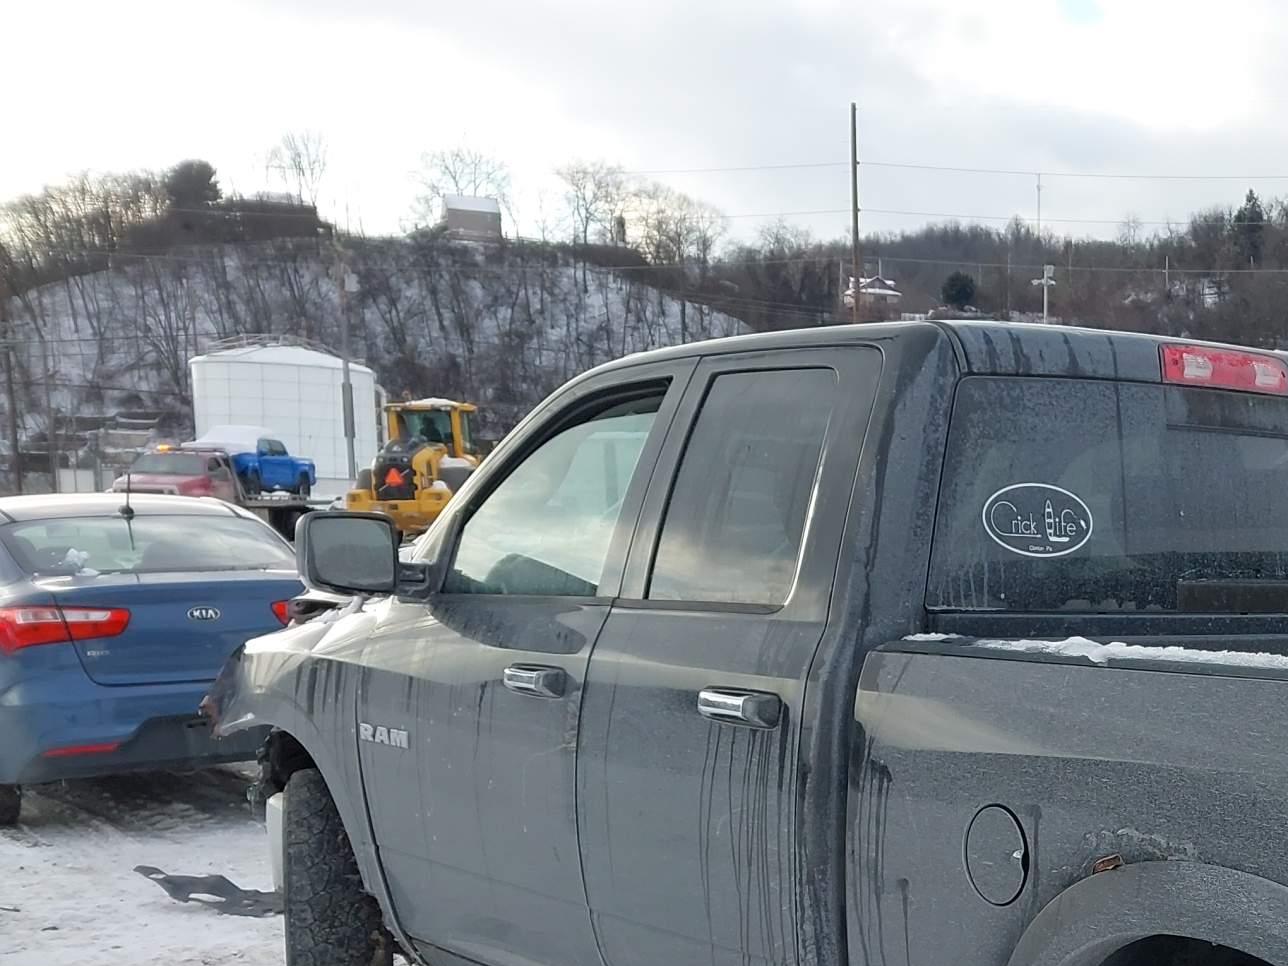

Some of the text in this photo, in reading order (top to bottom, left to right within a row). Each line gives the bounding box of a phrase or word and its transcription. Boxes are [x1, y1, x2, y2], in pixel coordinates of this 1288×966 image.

[991, 499, 1077, 542] Crick Life
[359, 722, 409, 749] RAM
